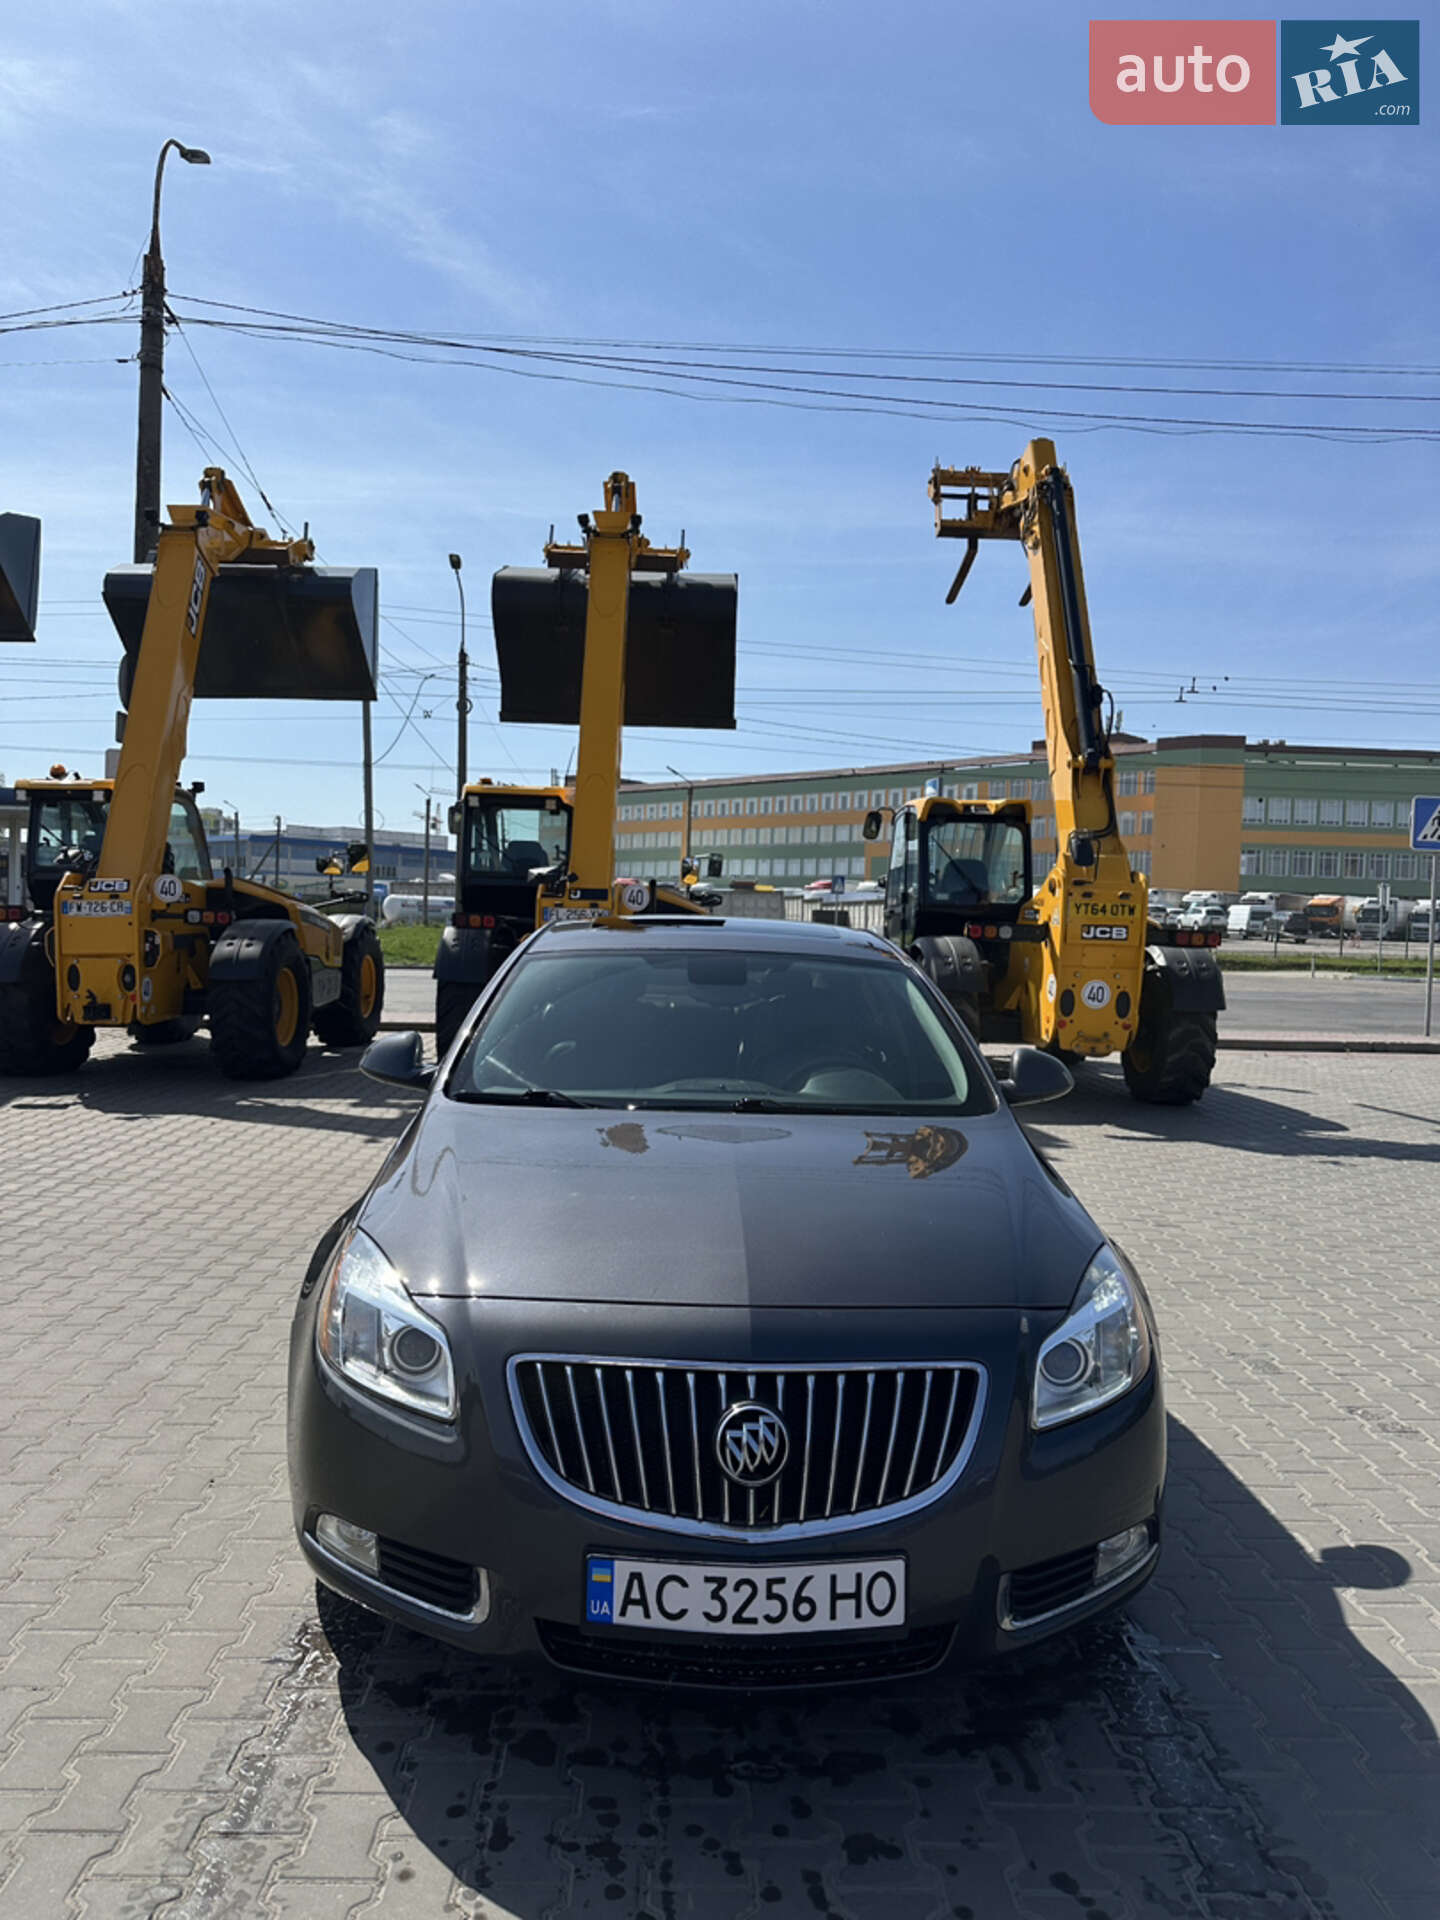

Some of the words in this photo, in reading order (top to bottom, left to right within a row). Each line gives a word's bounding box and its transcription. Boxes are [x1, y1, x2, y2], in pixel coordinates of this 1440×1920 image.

[189, 560, 205, 635] JCB
[90, 881, 128, 892] JCB
[160, 880, 177, 897] 40
[627, 889, 644, 906] 40
[1075, 903, 1107, 916] YT64
[1082, 926, 1127, 939] JCB
[1087, 986, 1105, 1003] 40
[618, 1571, 689, 1621] AC
[702, 1575, 817, 1625] 3256
[829, 1570, 897, 1621] HO
[591, 1600, 611, 1616] UA
